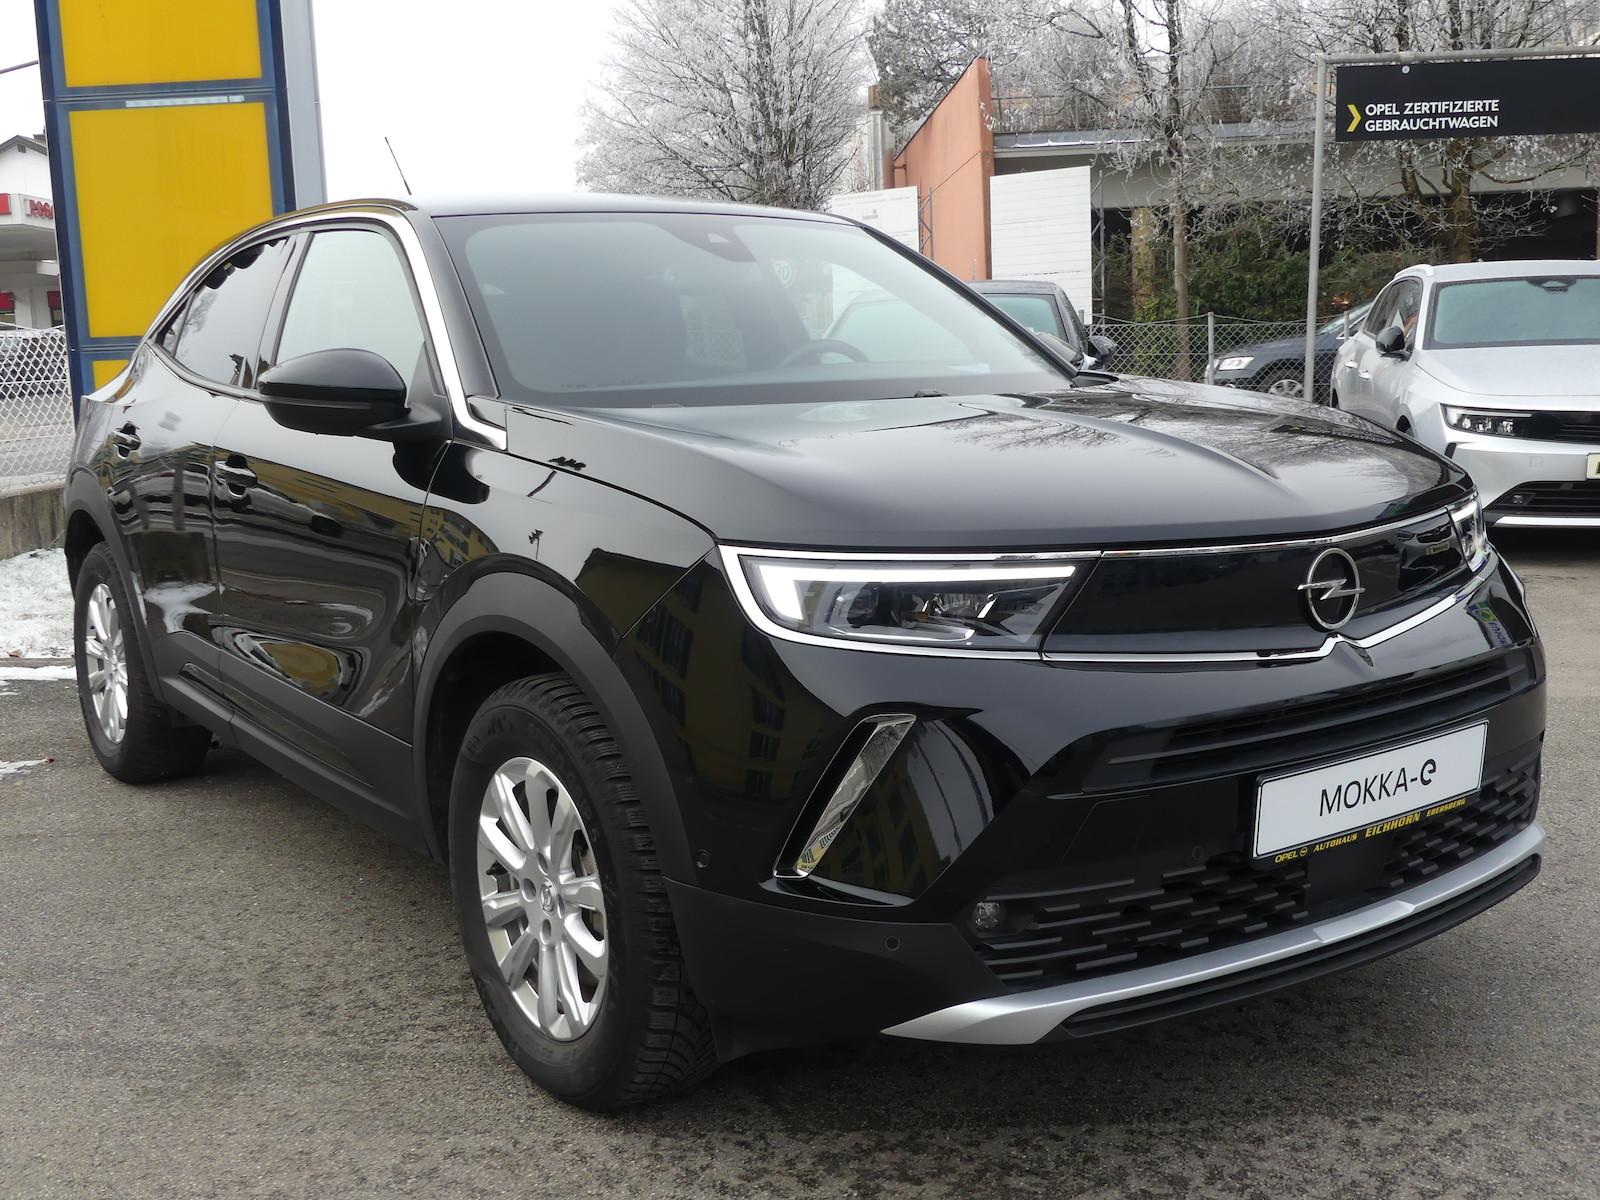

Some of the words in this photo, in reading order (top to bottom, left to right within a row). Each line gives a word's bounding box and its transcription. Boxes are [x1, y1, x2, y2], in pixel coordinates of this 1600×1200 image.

[1365, 103, 1400, 116] OPEL
[1403, 100, 1499, 114] ZERTIFIZIERTE
[1365, 116, 1498, 131] GEBRAUCHTWAGEN
[1319, 758, 1437, 816] MOKKA-e
[1274, 851, 1298, 863] OPEL
[1313, 833, 1357, 852] AUTOHAUS
[1364, 812, 1421, 838] EICHHORN
[1426, 798, 1465, 817] EBERSBERG
